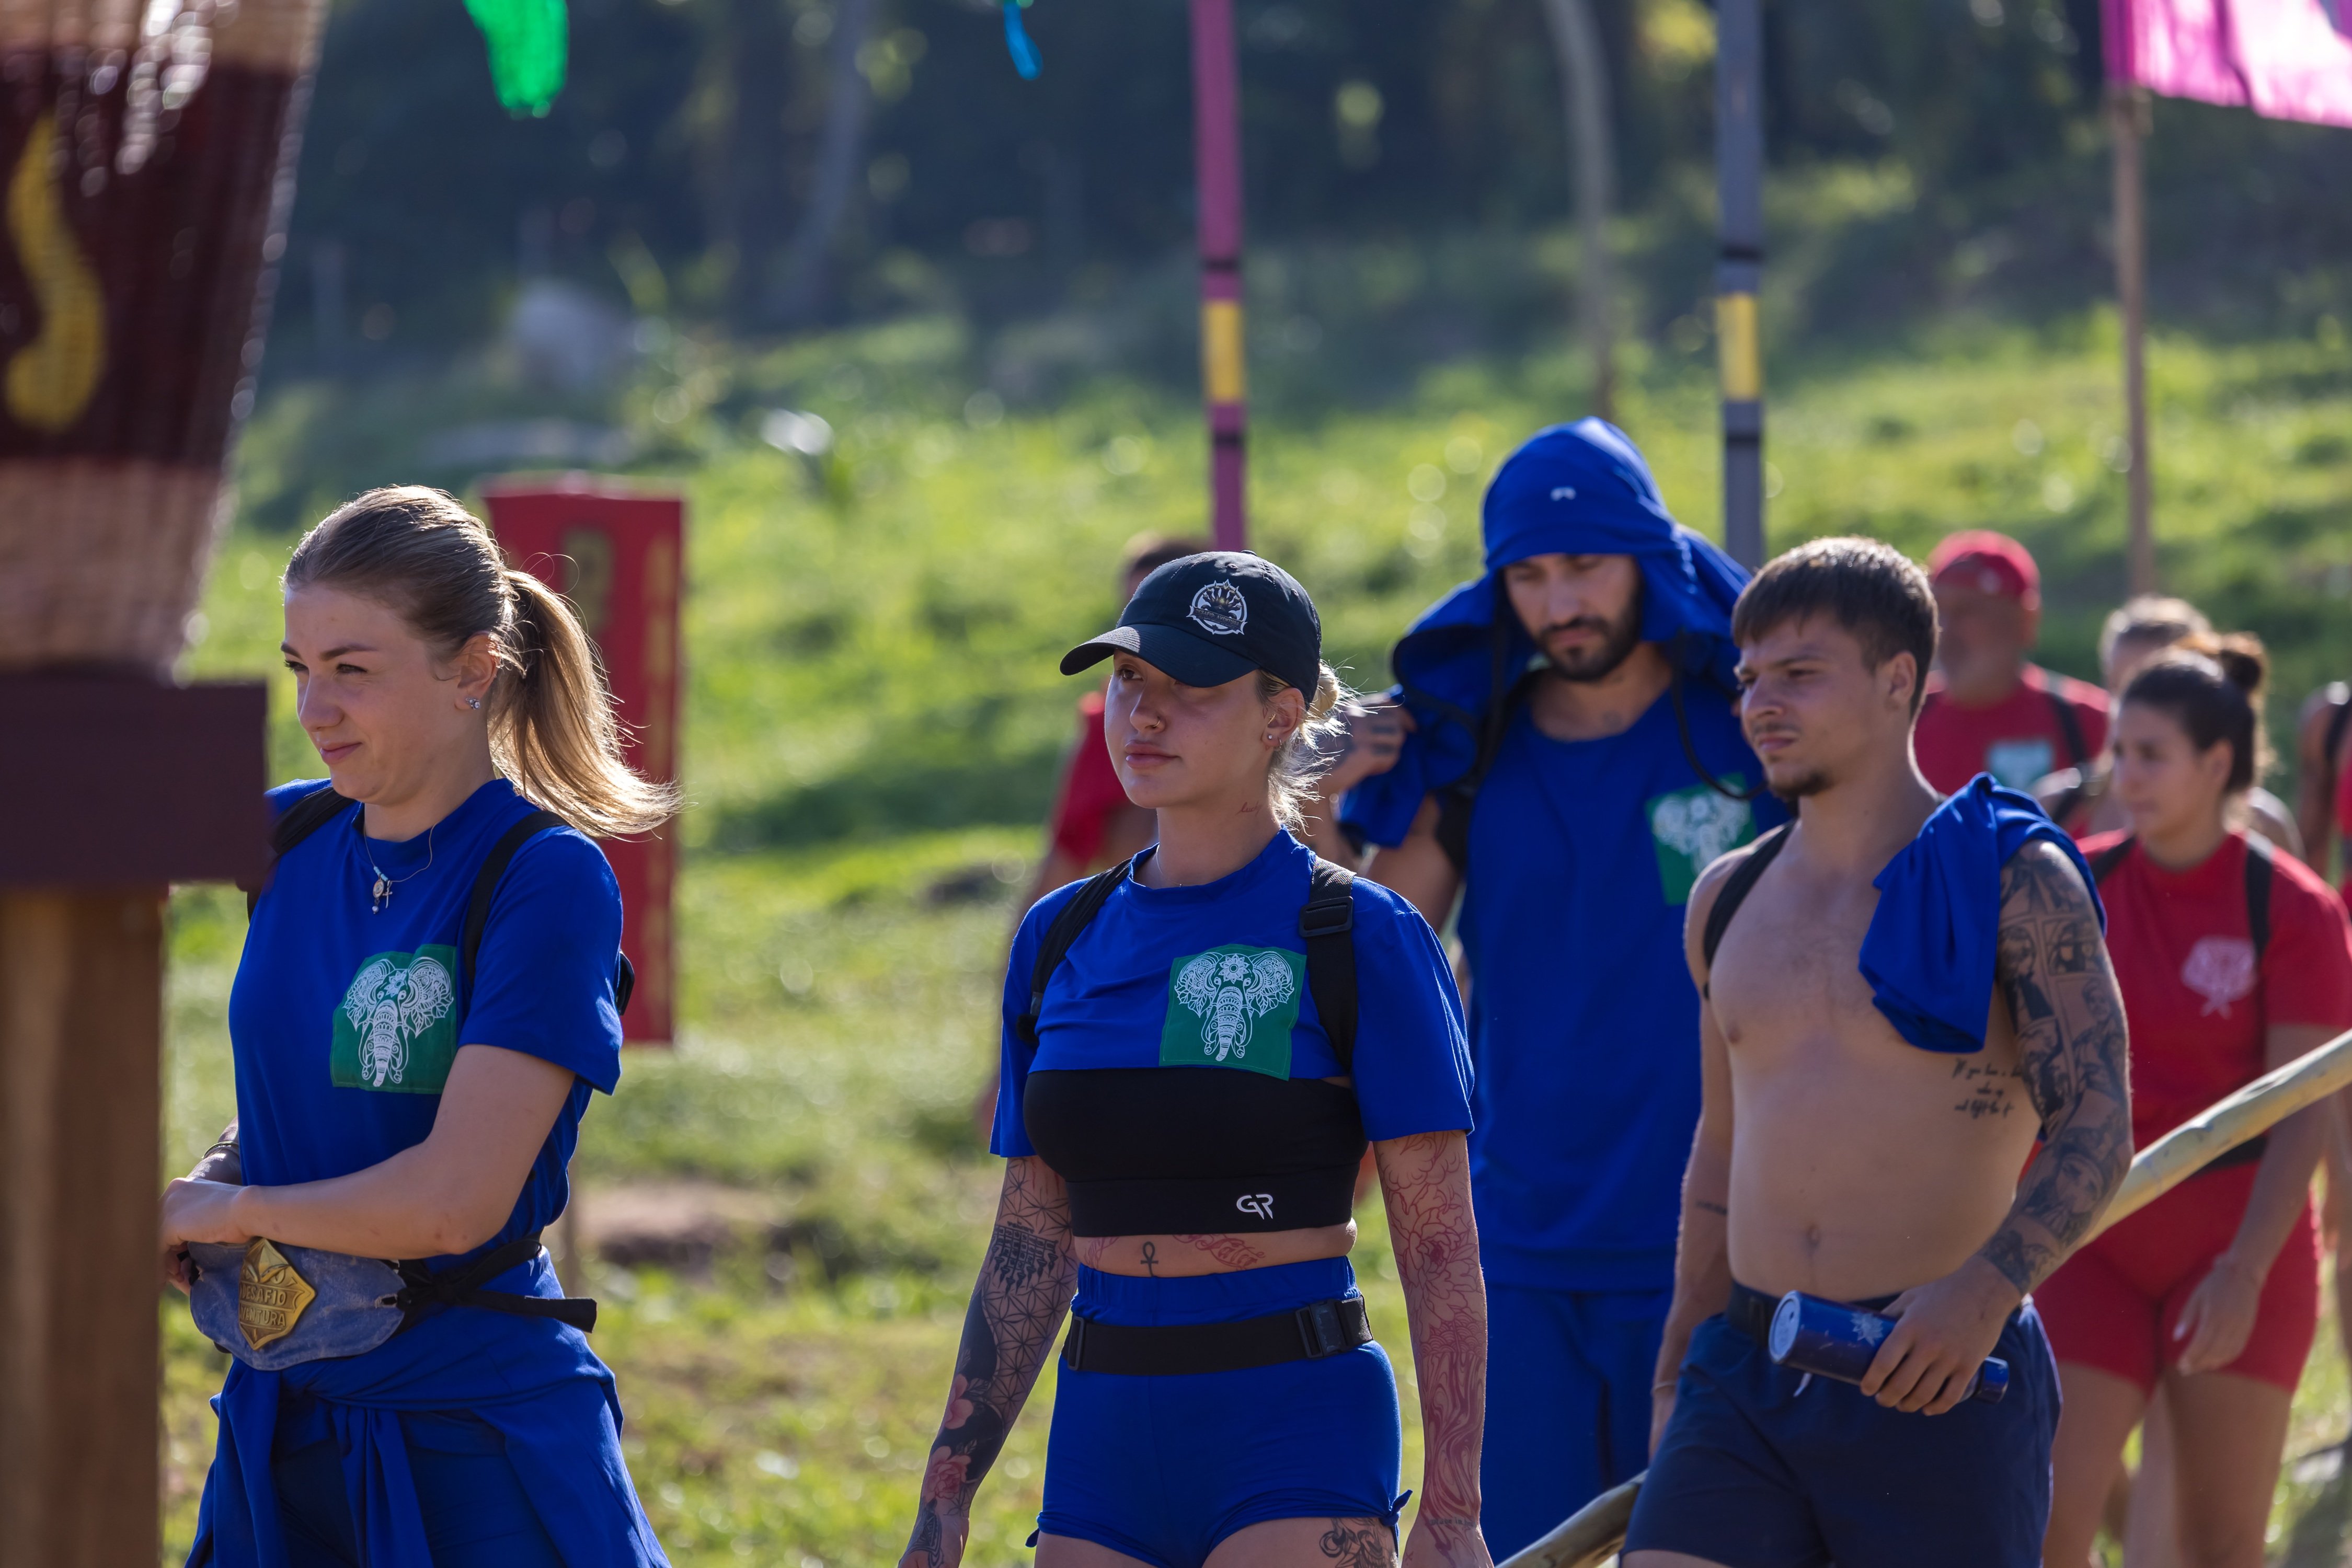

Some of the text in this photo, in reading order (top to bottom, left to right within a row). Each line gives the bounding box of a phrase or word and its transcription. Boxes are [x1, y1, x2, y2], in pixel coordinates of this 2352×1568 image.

[1217, 615, 1240, 626] AVENTURA
[1236, 1194, 1273, 1220] GR
[242, 1284, 287, 1306] DESAFIO
[240, 1306, 286, 1327] VENTURA
